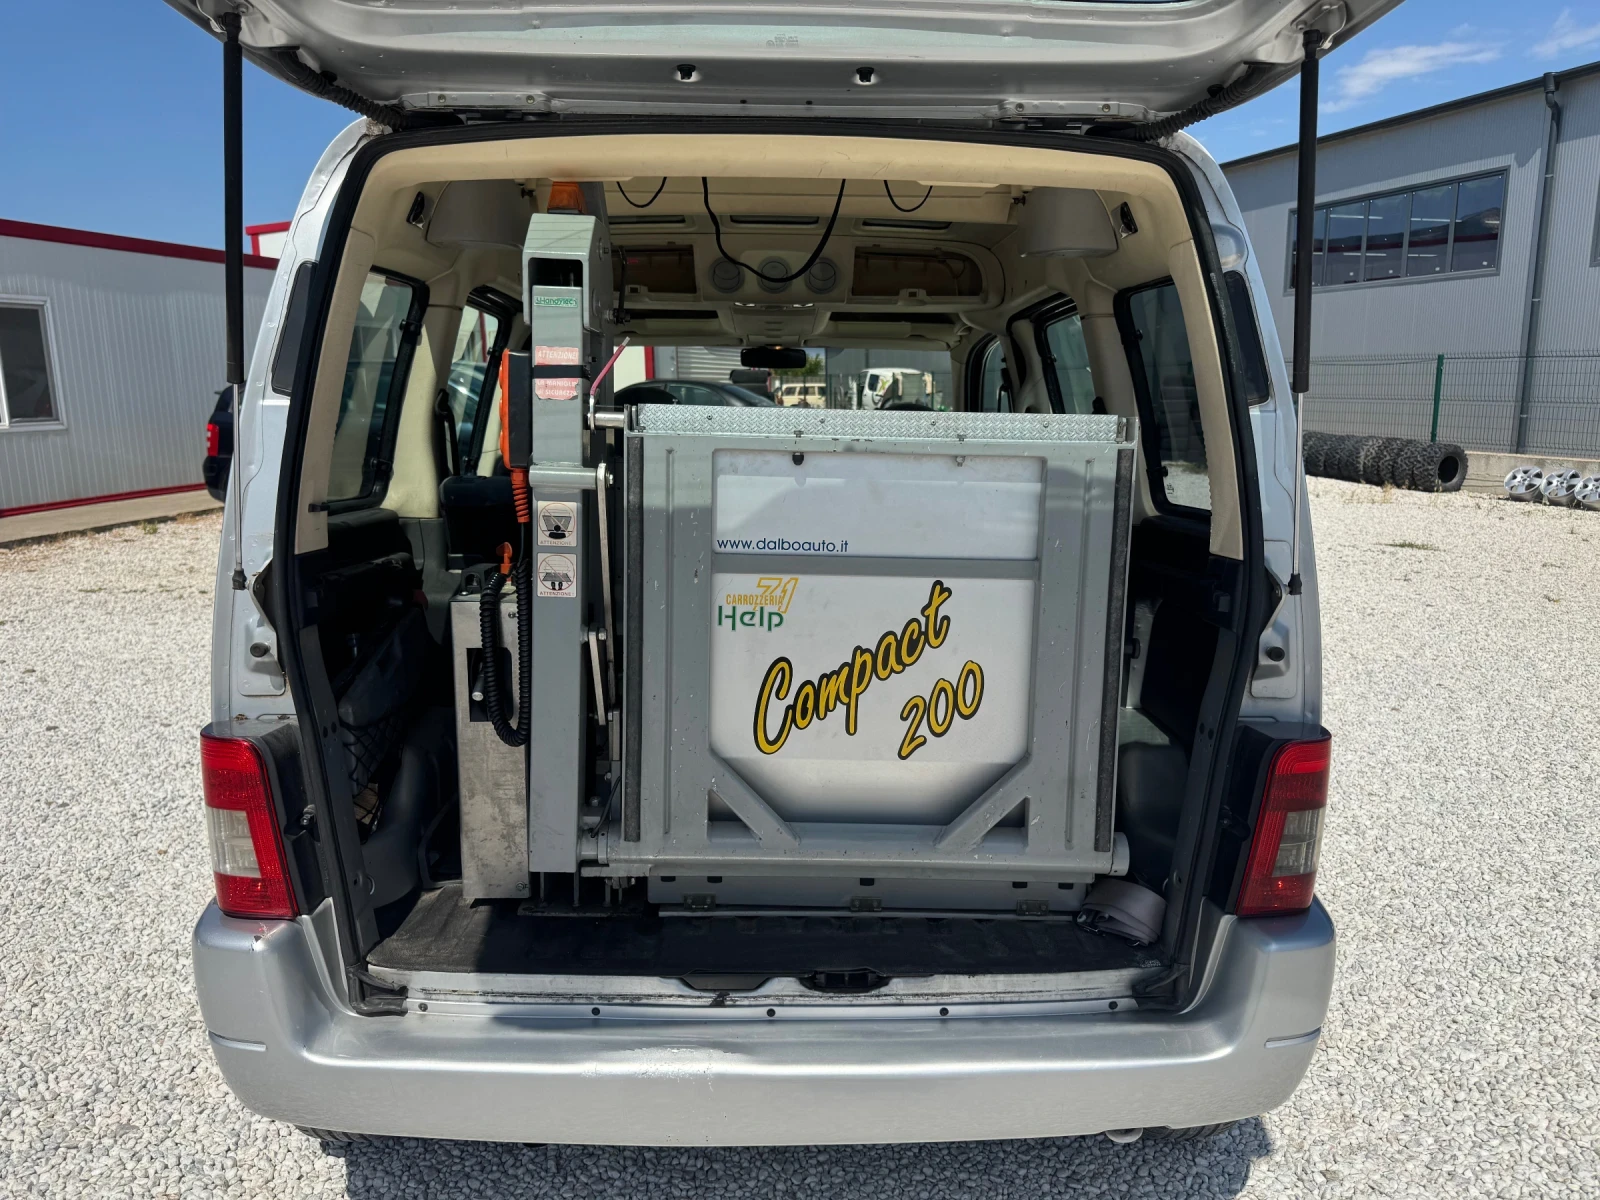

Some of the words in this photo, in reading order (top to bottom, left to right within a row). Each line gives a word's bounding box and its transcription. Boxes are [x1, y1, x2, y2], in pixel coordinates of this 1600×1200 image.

[716, 538, 849, 553] www.dalboauto.it
[726, 593, 783, 606] CARROZZERIA
[717, 605, 784, 632] Help
[753, 579, 952, 755] Compact
[898, 660, 984, 760] 200
